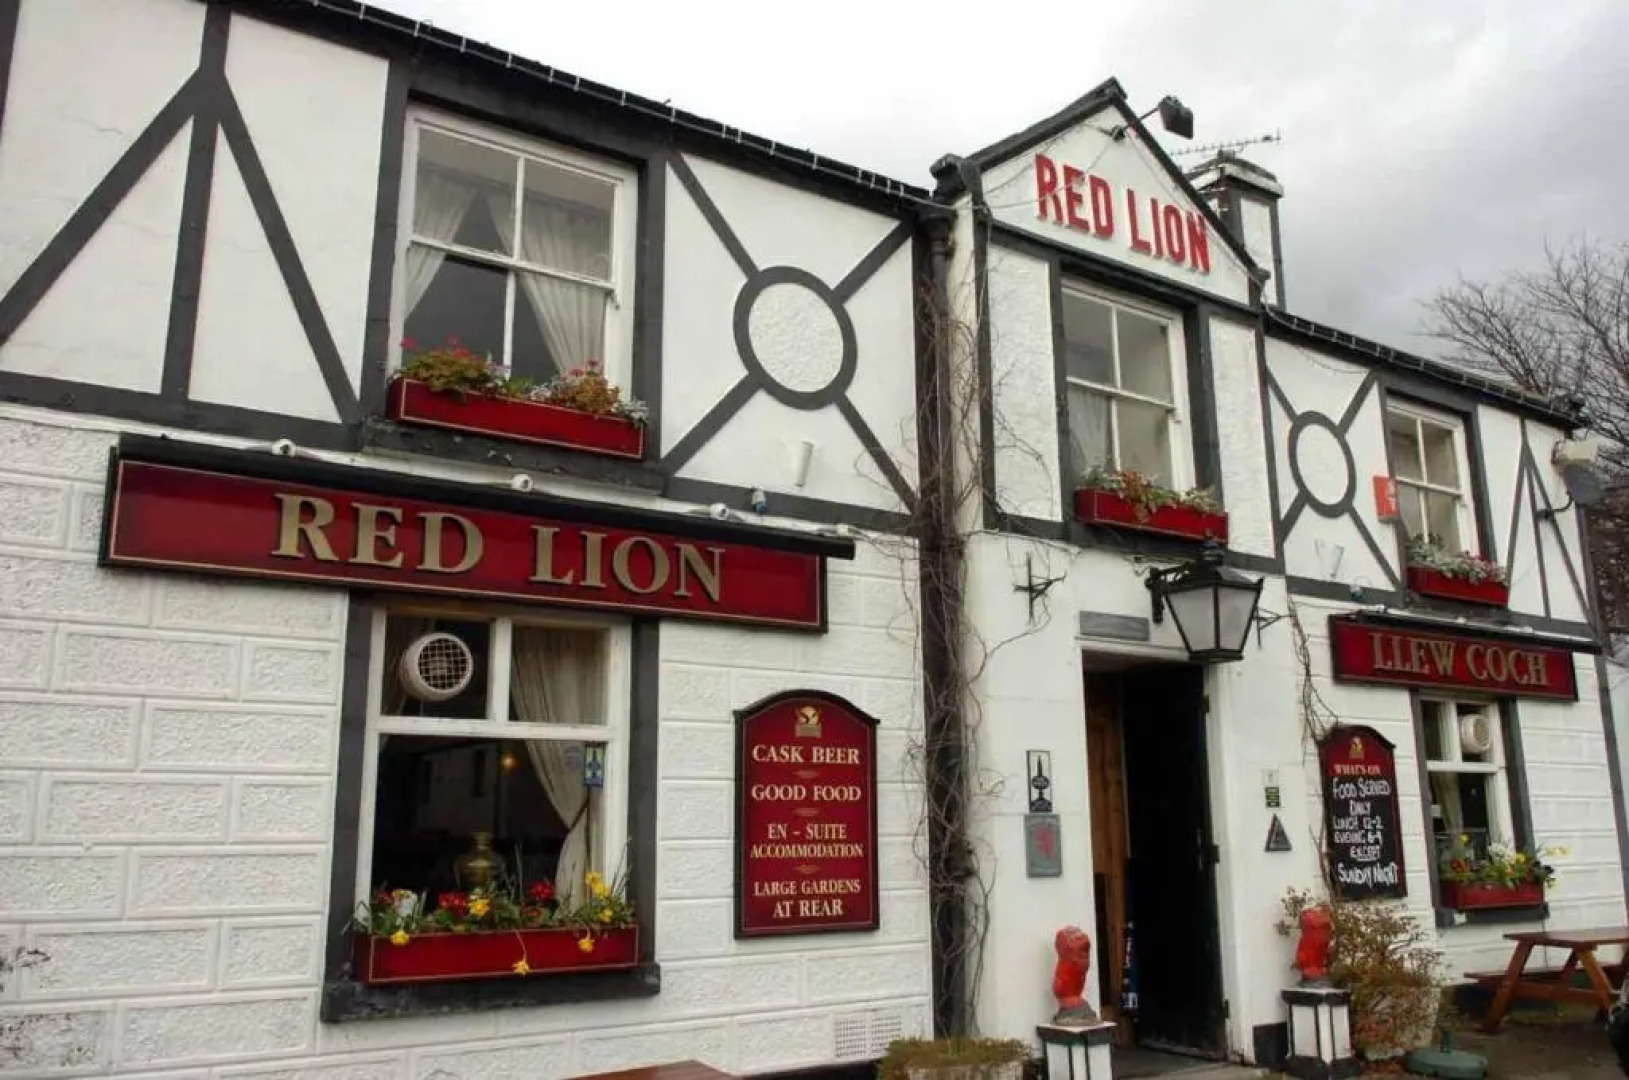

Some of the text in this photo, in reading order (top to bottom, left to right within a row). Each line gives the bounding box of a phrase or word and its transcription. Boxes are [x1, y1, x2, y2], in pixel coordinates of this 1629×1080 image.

[1035, 153, 1210, 274] RED LION
[271, 493, 726, 602] RED LION
[1368, 632, 1548, 686] LLEW COCH
[753, 745, 860, 765] CASK BEER
[752, 784, 861, 802] GOOD FOOD
[768, 824, 787, 839] EN
[806, 824, 846, 840] SUITE
[751, 843, 863, 859] ACCOMMODATION
[754, 879, 861, 896] LARGE GARDENS
[773, 899, 843, 919] AT REAR
